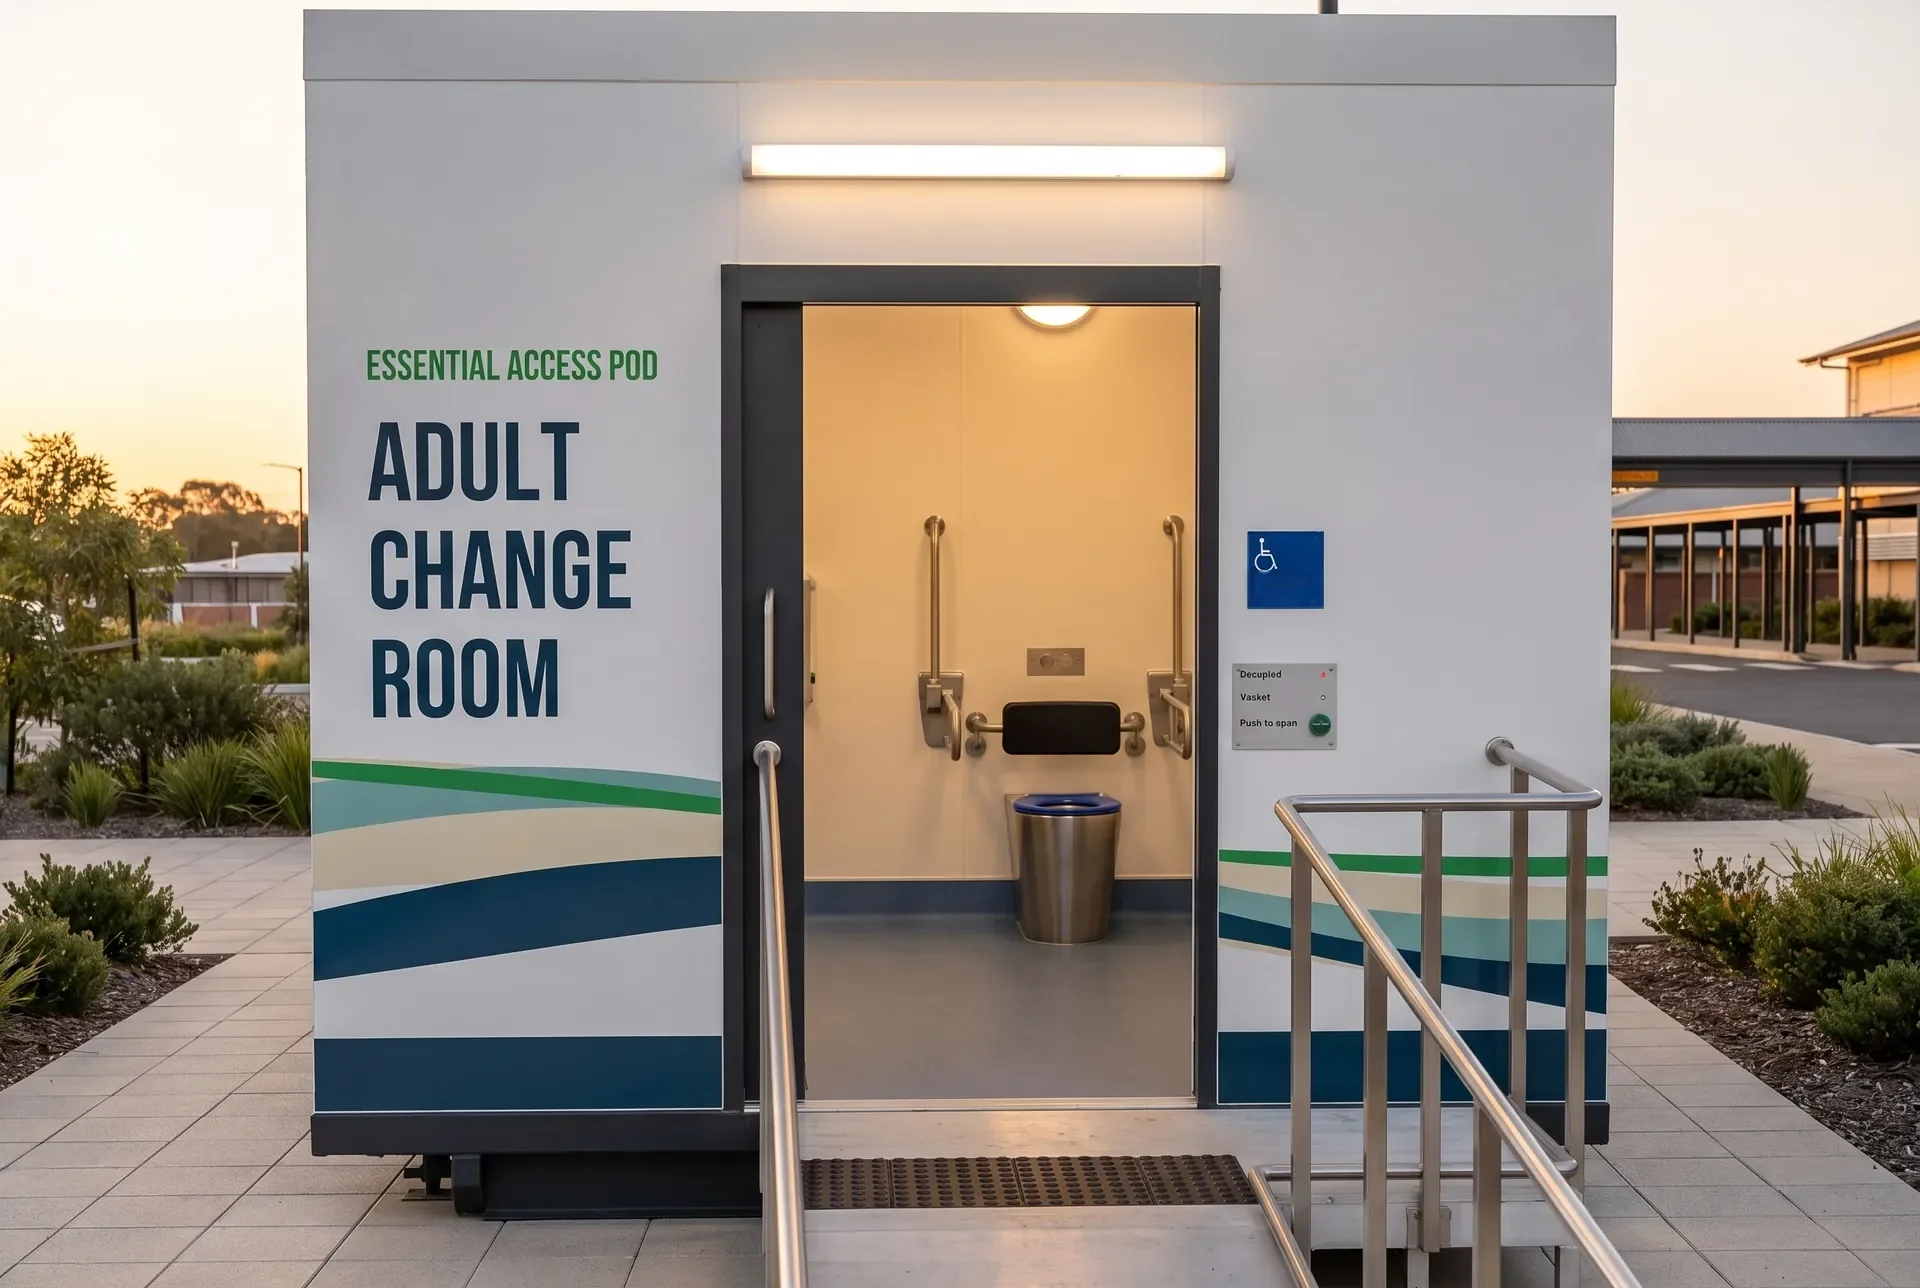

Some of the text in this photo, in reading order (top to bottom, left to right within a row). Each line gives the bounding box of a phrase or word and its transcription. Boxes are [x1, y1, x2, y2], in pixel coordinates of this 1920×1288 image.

[367, 349, 658, 381] ESSENTIAL ACCESS POD
[368, 421, 580, 502] ADULT
[370, 529, 632, 610] CHANGE
[372, 638, 559, 719] ROOM
[1240, 670, 1282, 680] Decupled
[1240, 693, 1271, 701] Vasket
[1240, 719, 1298, 729] Push to span
